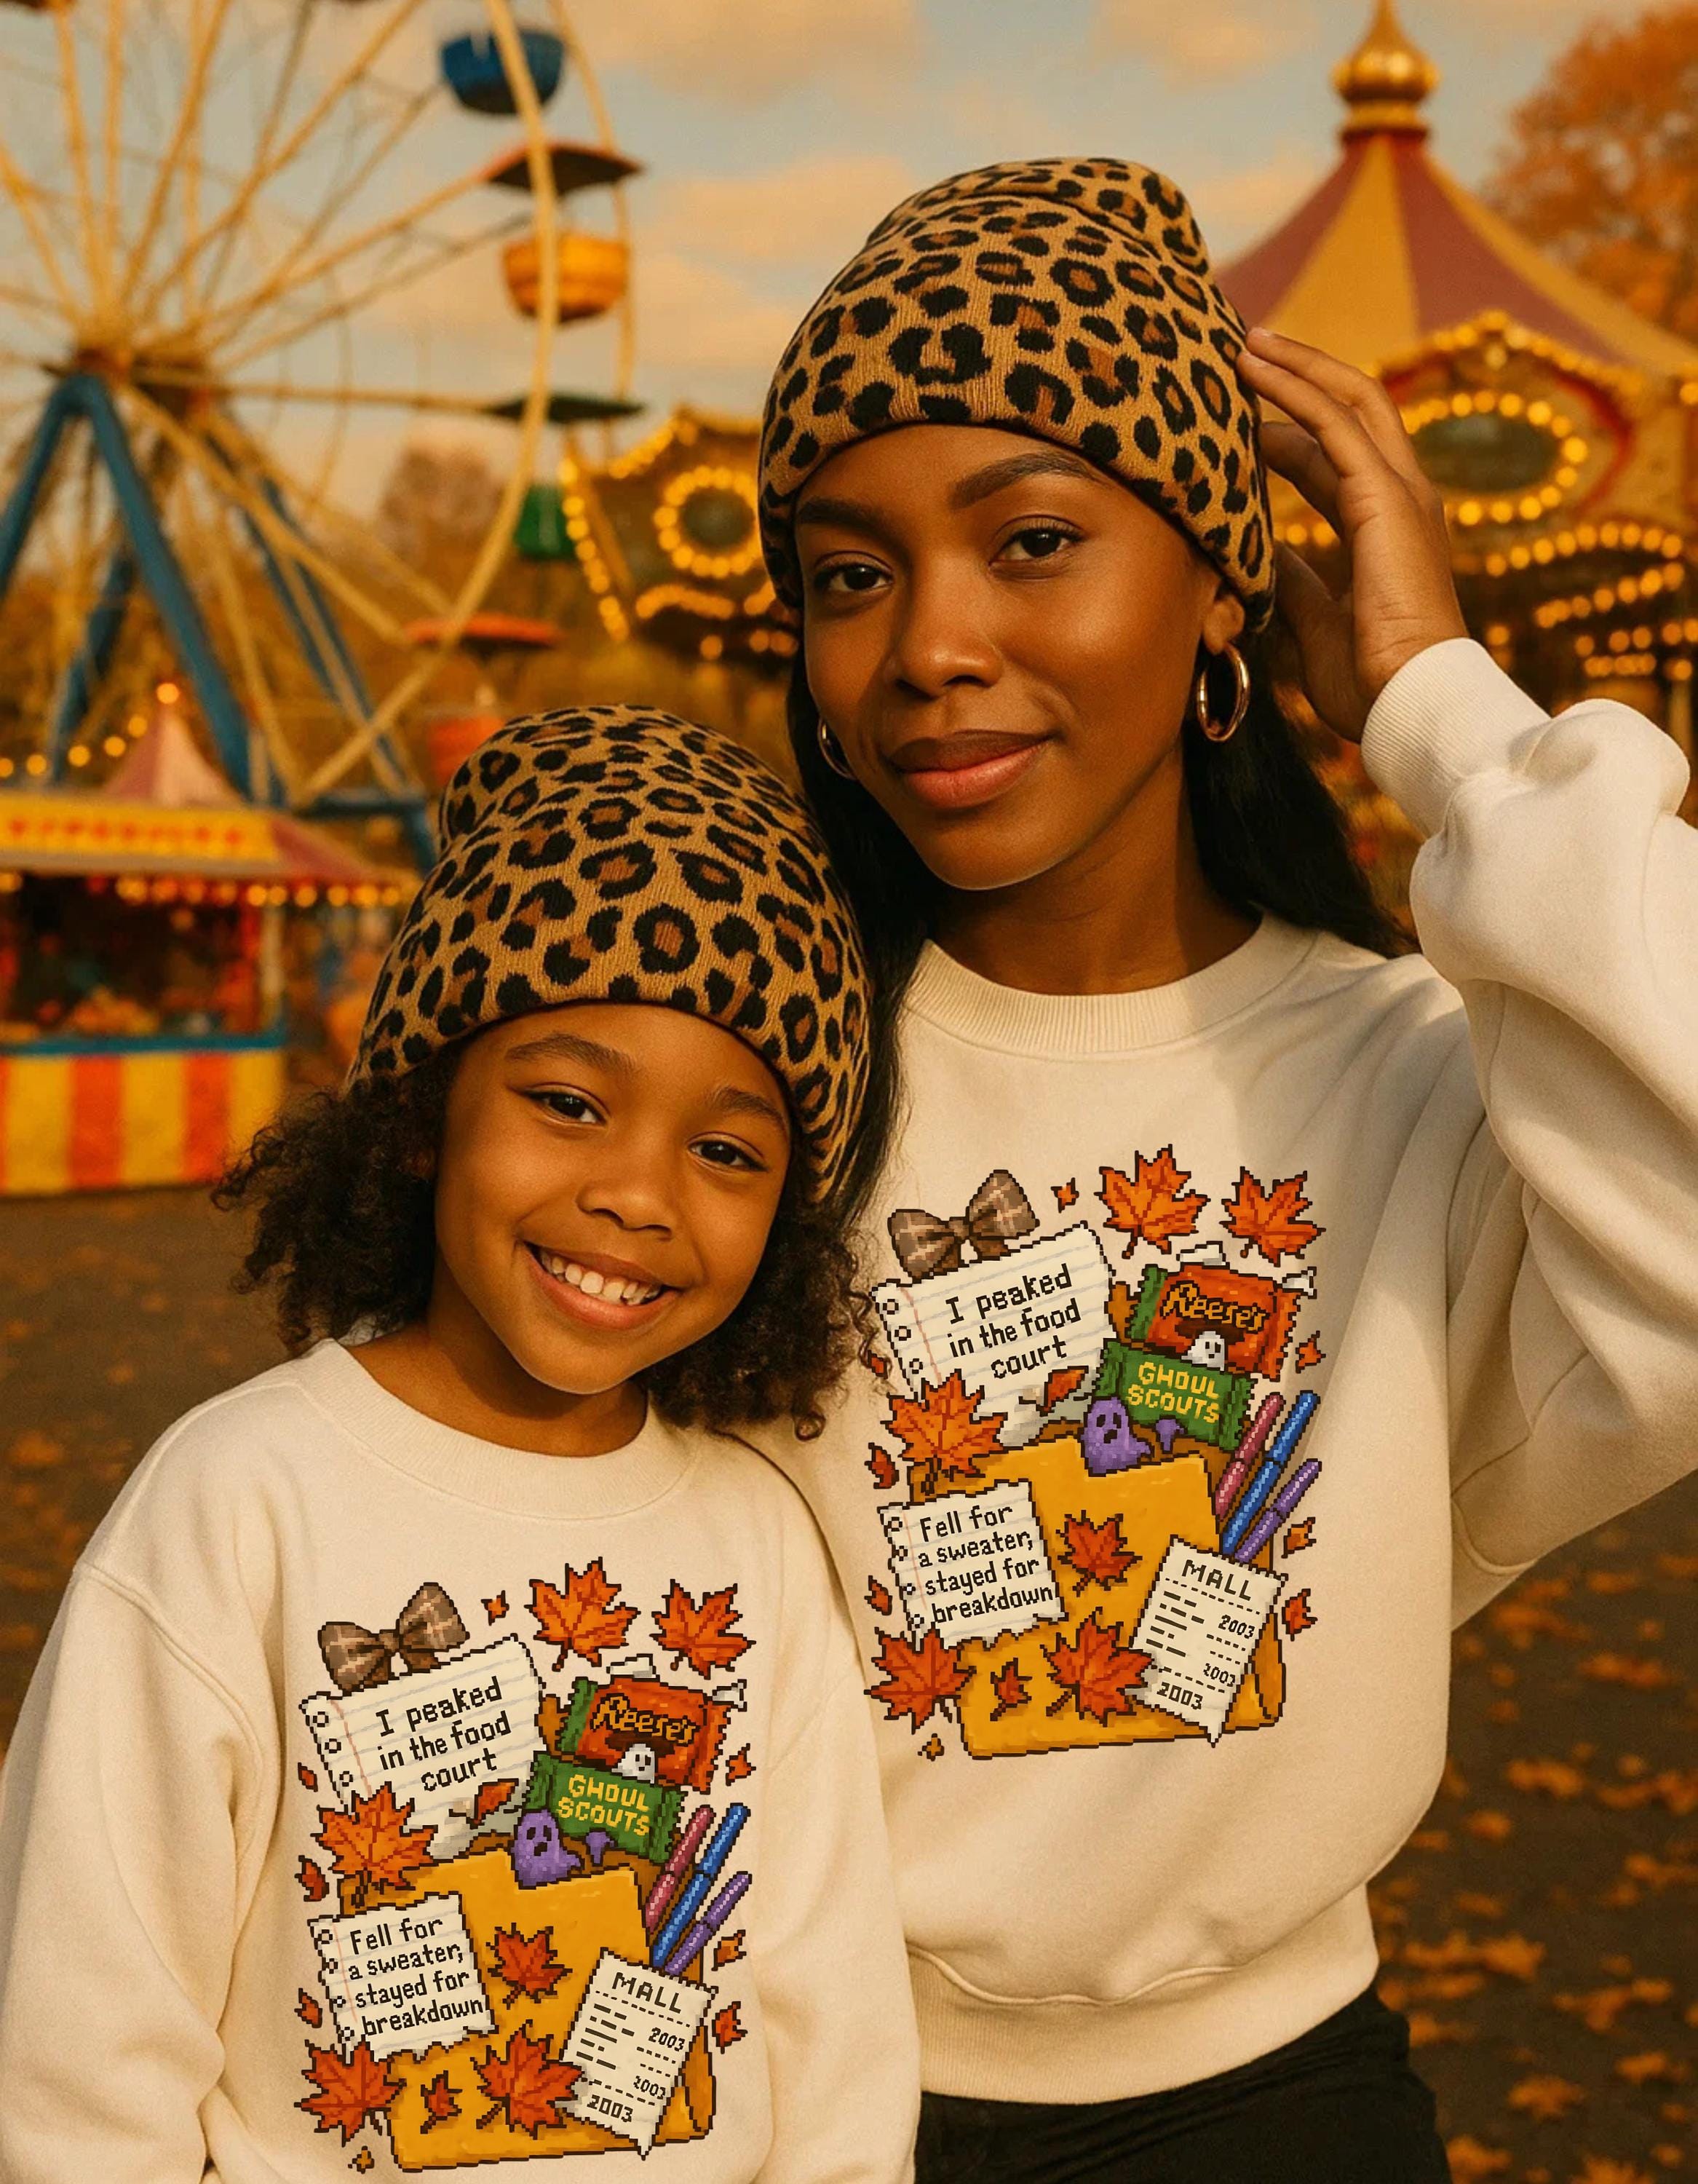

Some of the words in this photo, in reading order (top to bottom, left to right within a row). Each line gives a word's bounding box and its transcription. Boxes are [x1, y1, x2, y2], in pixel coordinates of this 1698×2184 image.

[945, 1297, 964, 1324] I
[976, 1263, 1072, 1319] peaked
[947, 1333, 975, 1358] in
[979, 1323, 1017, 1348] the
[1020, 1297, 1082, 1337] food
[991, 1334, 1067, 1379] court
[1138, 1361, 1219, 1398] GHOUL
[1127, 1385, 1219, 1423] SCOUTS
[919, 1511, 962, 1542] Fell
[969, 1505, 1013, 1529] for
[918, 1552, 933, 1567] a
[937, 1531, 1034, 1563] sweater,
[925, 1561, 997, 1596] stayed
[1002, 1557, 1039, 1580] for
[1181, 1559, 1253, 1602] MALL
[932, 1586, 1053, 1623] breakdown
[1218, 1614, 1255, 1639] 2003
[376, 1709, 394, 1737] I
[406, 1676, 502, 1732] peaked
[1157, 1682, 1203, 1710] 2003
[377, 1746, 405, 1770] in
[409, 1736, 448, 1761] the
[451, 1710, 512, 1749] food
[421, 1747, 497, 1792] court
[568, 1773, 649, 1811] GHOUL
[557, 1798, 649, 1836] SCOUTS
[349, 1923, 392, 1955] Fell
[399, 1918, 443, 1942] for
[348, 1965, 363, 1980] a
[367, 1944, 464, 1976] sweater,
[355, 1974, 427, 2009] stayed
[432, 1970, 469, 1993] for
[611, 1972, 683, 2014] MALL
[362, 1999, 483, 2036] breakdown
[648, 2027, 686, 2052] 2003
[587, 2094, 633, 2123] 2003
